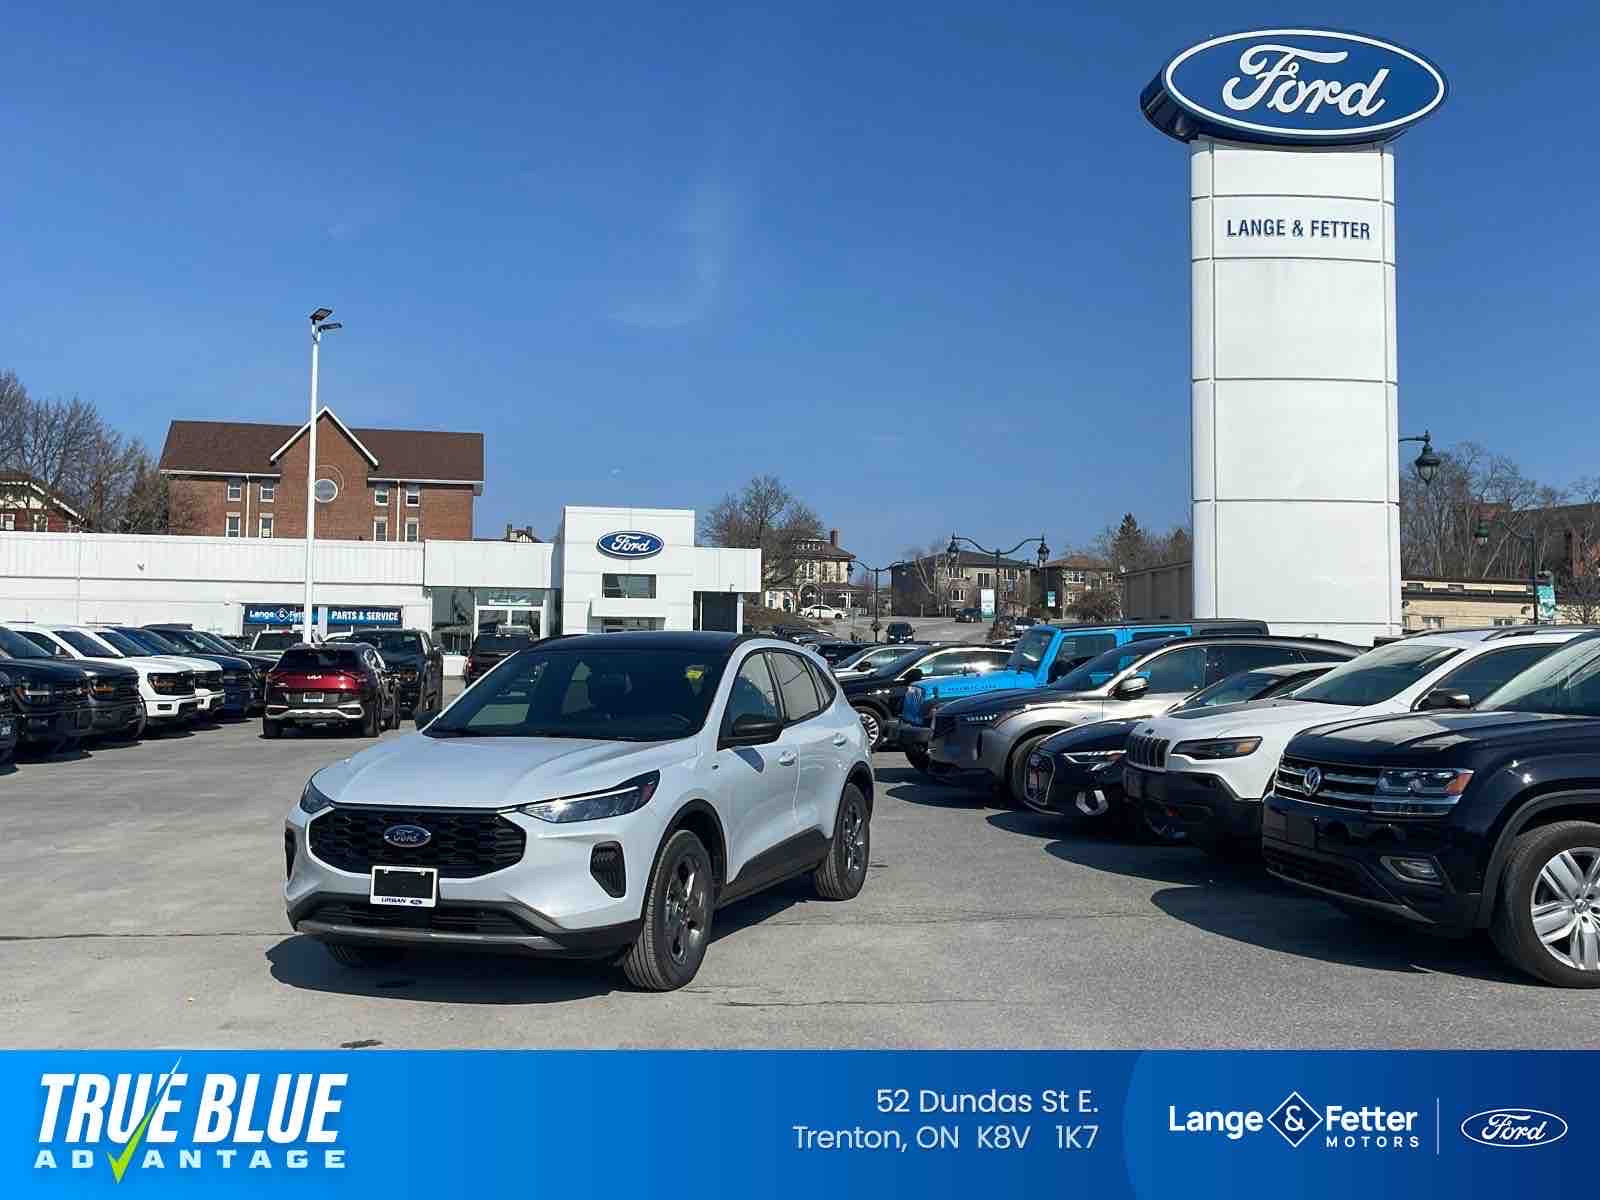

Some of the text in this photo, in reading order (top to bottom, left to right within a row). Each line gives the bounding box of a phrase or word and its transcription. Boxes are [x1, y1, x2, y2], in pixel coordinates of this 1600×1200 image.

[1222, 44, 1390, 117] Ford
[1227, 219, 1371, 240] LANGE & FETTER
[611, 534, 650, 551] Ford
[249, 610, 275, 618] Lange
[331, 611, 399, 621] PARTS & SERVICE
